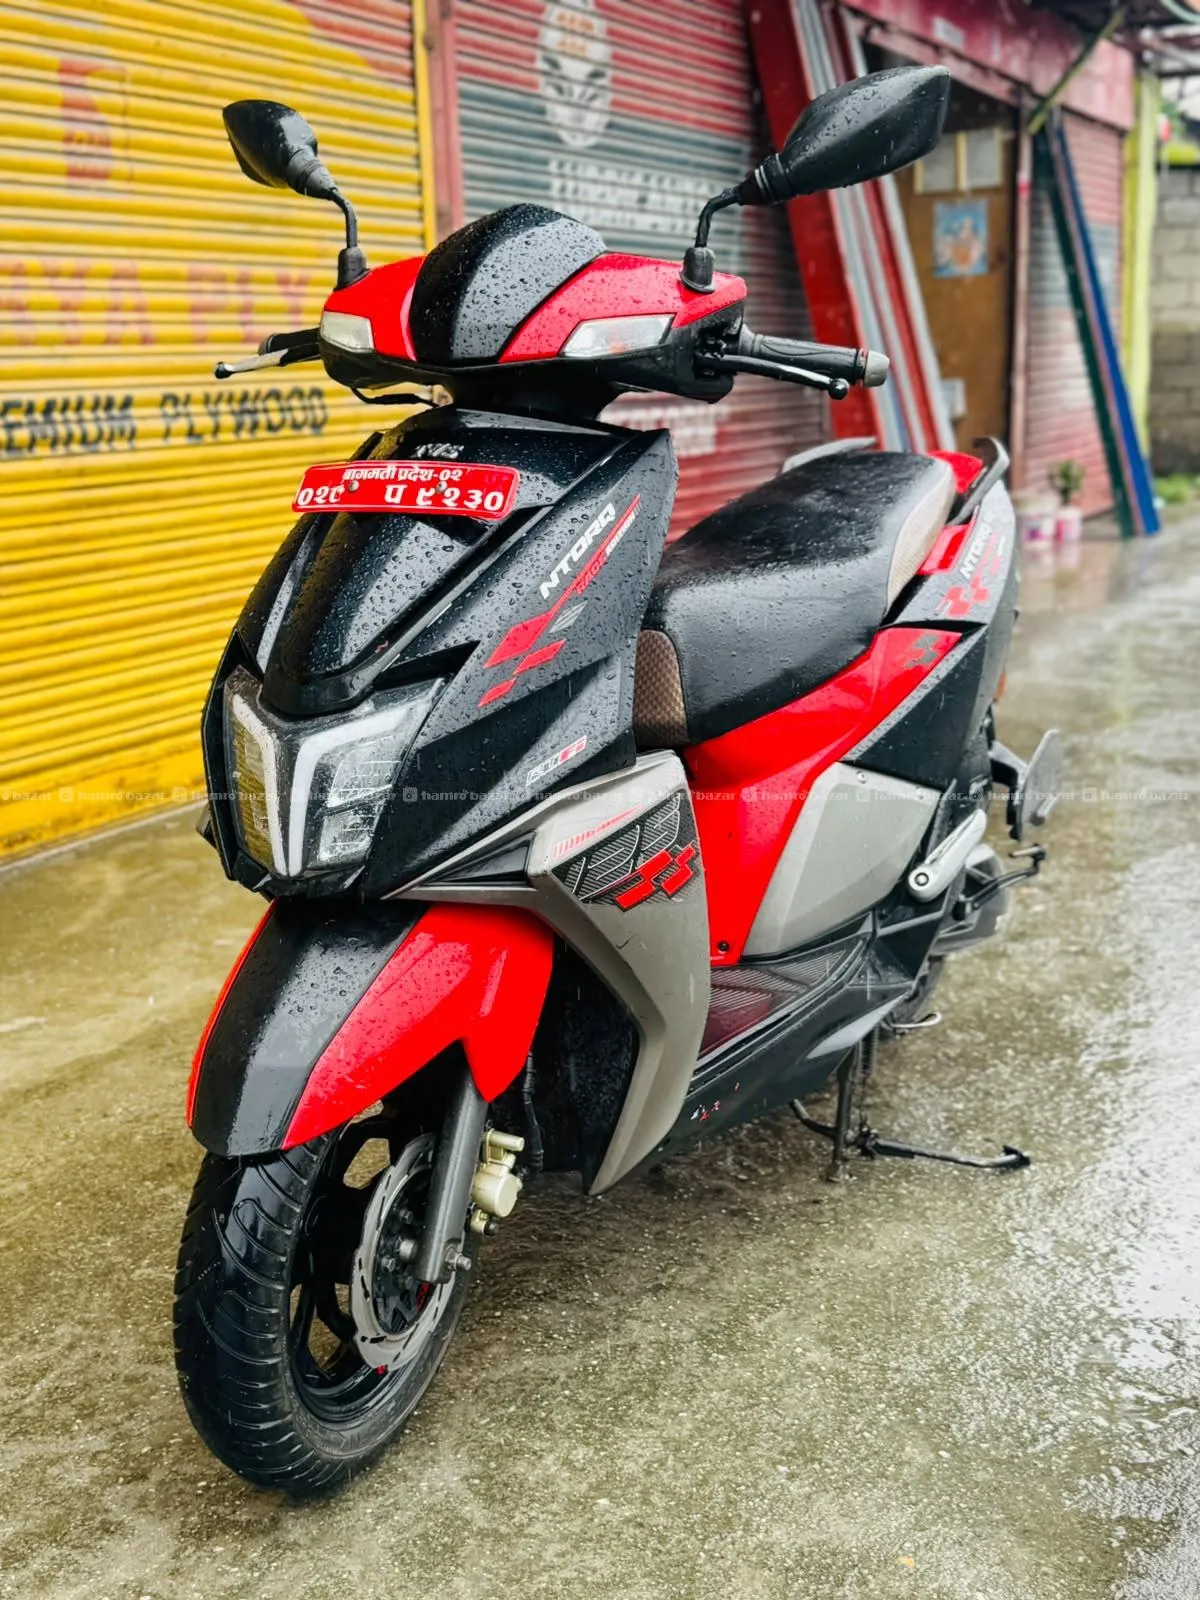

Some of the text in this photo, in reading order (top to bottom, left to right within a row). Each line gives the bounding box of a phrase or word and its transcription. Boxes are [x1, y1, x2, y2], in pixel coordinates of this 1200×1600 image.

[161, 386, 328, 442] PLYWOOD
[384, 483, 408, 504] प
[539, 502, 617, 600] NTORQ
